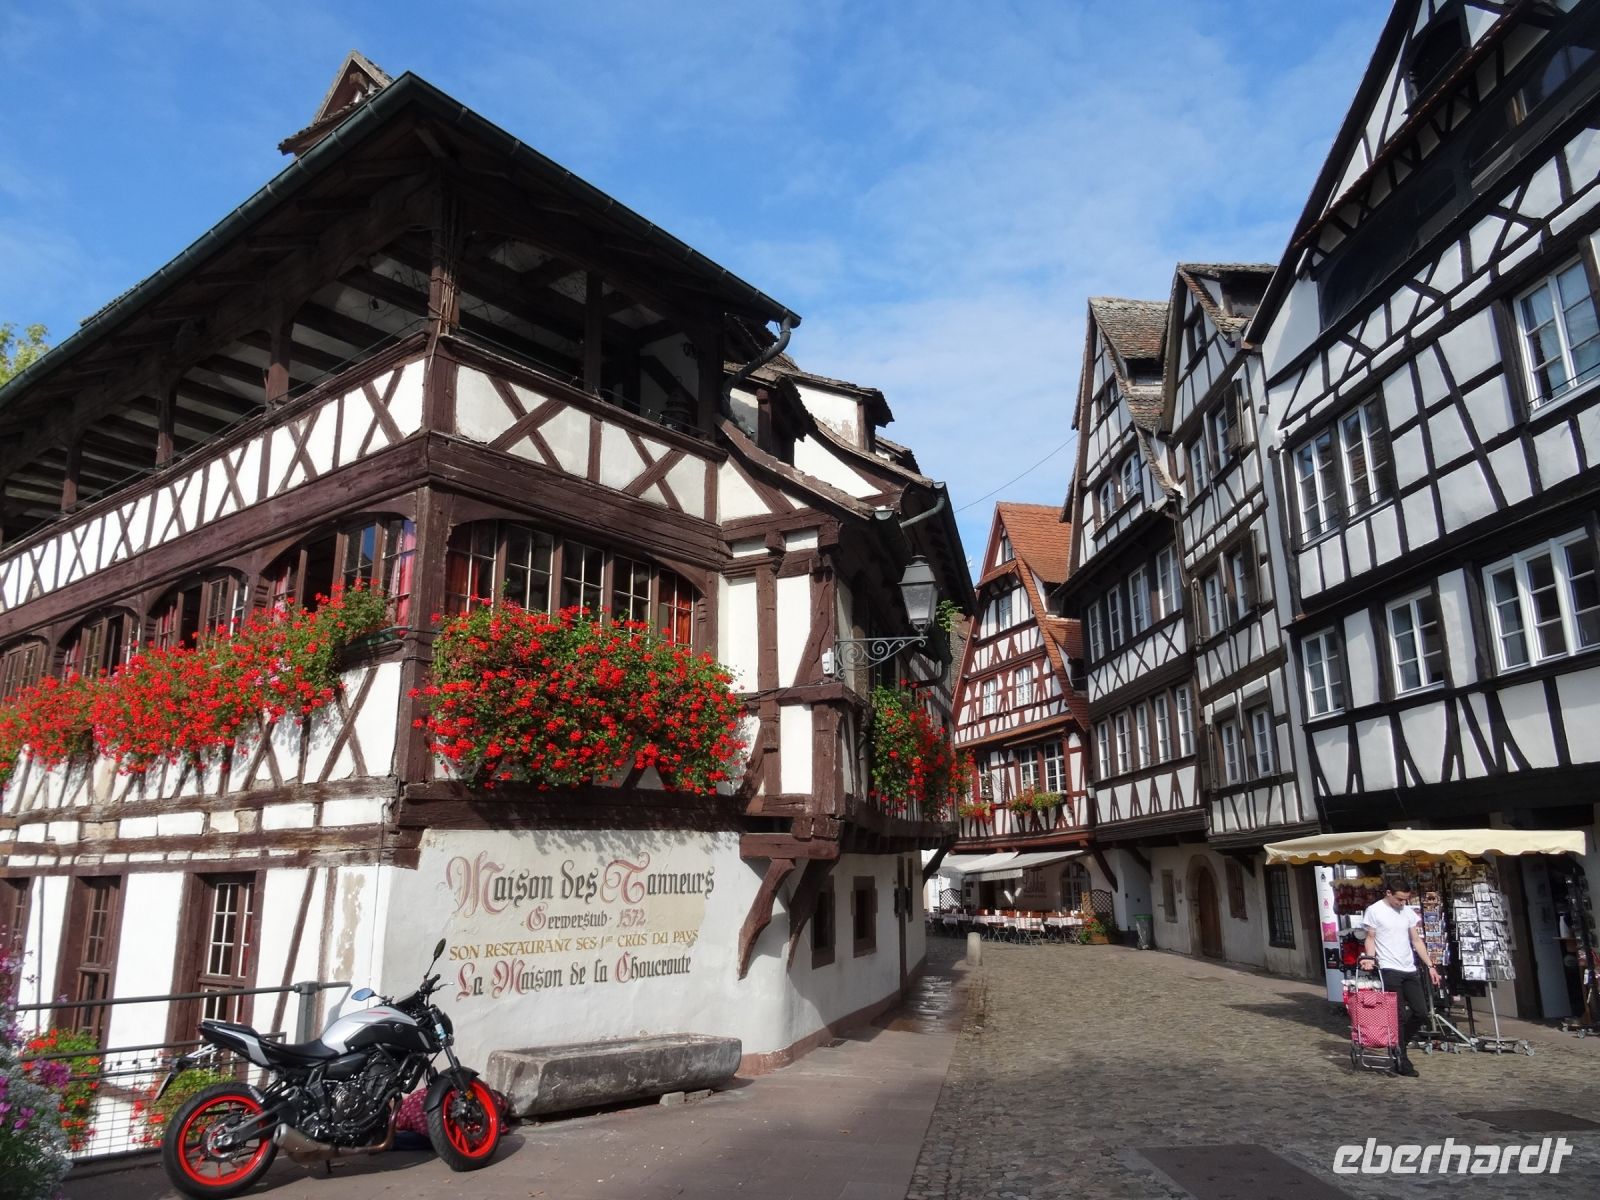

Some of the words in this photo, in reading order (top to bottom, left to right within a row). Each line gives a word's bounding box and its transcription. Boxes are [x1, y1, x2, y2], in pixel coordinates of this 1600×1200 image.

[446, 851, 554, 918] Maison
[561, 859, 599, 904] des
[600, 852, 715, 904] Tanneurs
[616, 908, 646, 929] 1572
[449, 944, 480, 961] SON
[484, 937, 573, 959] RESTAURANT
[576, 936, 597, 950] SES
[617, 932, 648, 946] CRUS
[652, 931, 669, 944] DU
[672, 929, 699, 943] PAYS
[456, 962, 483, 1002] La
[492, 958, 563, 999] Maison
[569, 961, 586, 986] de
[594, 959, 608, 983] la
[614, 951, 691, 983] Choucroute
